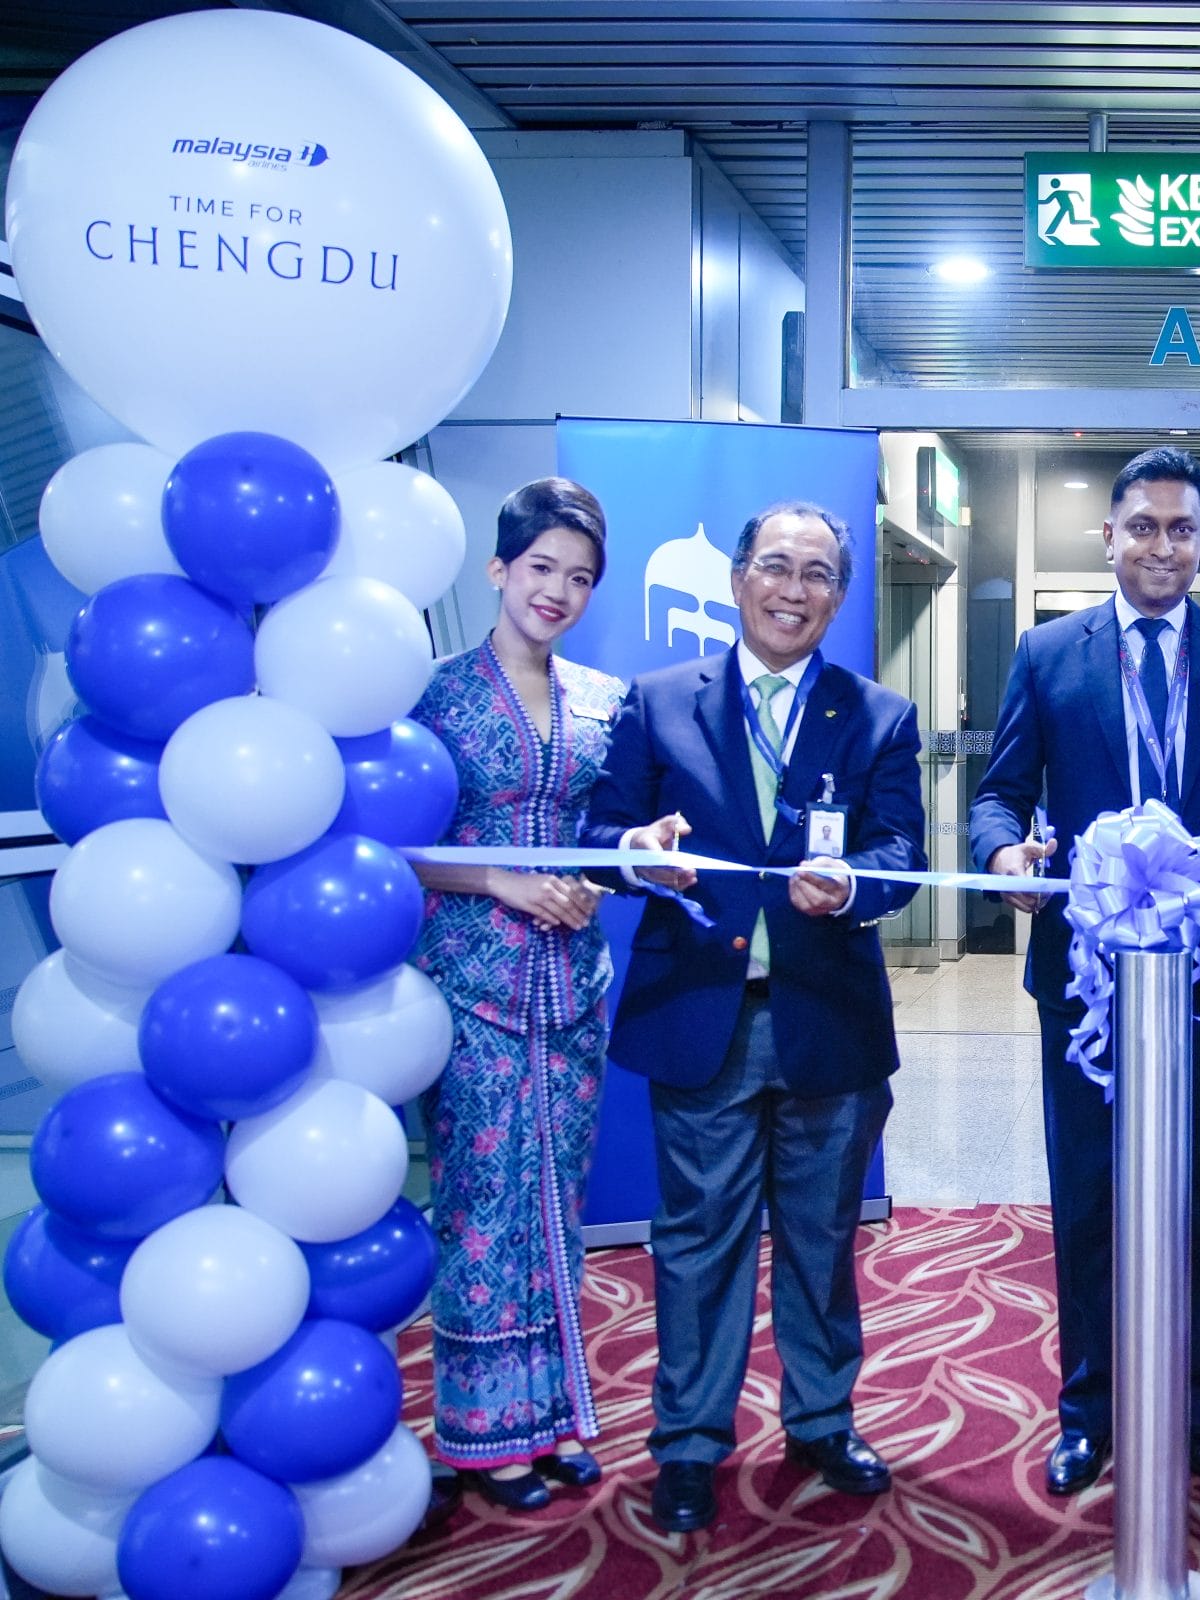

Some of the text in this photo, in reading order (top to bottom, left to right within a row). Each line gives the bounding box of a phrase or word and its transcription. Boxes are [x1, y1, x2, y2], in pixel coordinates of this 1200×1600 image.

[172, 136, 292, 163] malaysia
[247, 158, 288, 173] airlines
[168, 195, 304, 226] TIME FOR
[85, 220, 399, 291] CHENGDU
